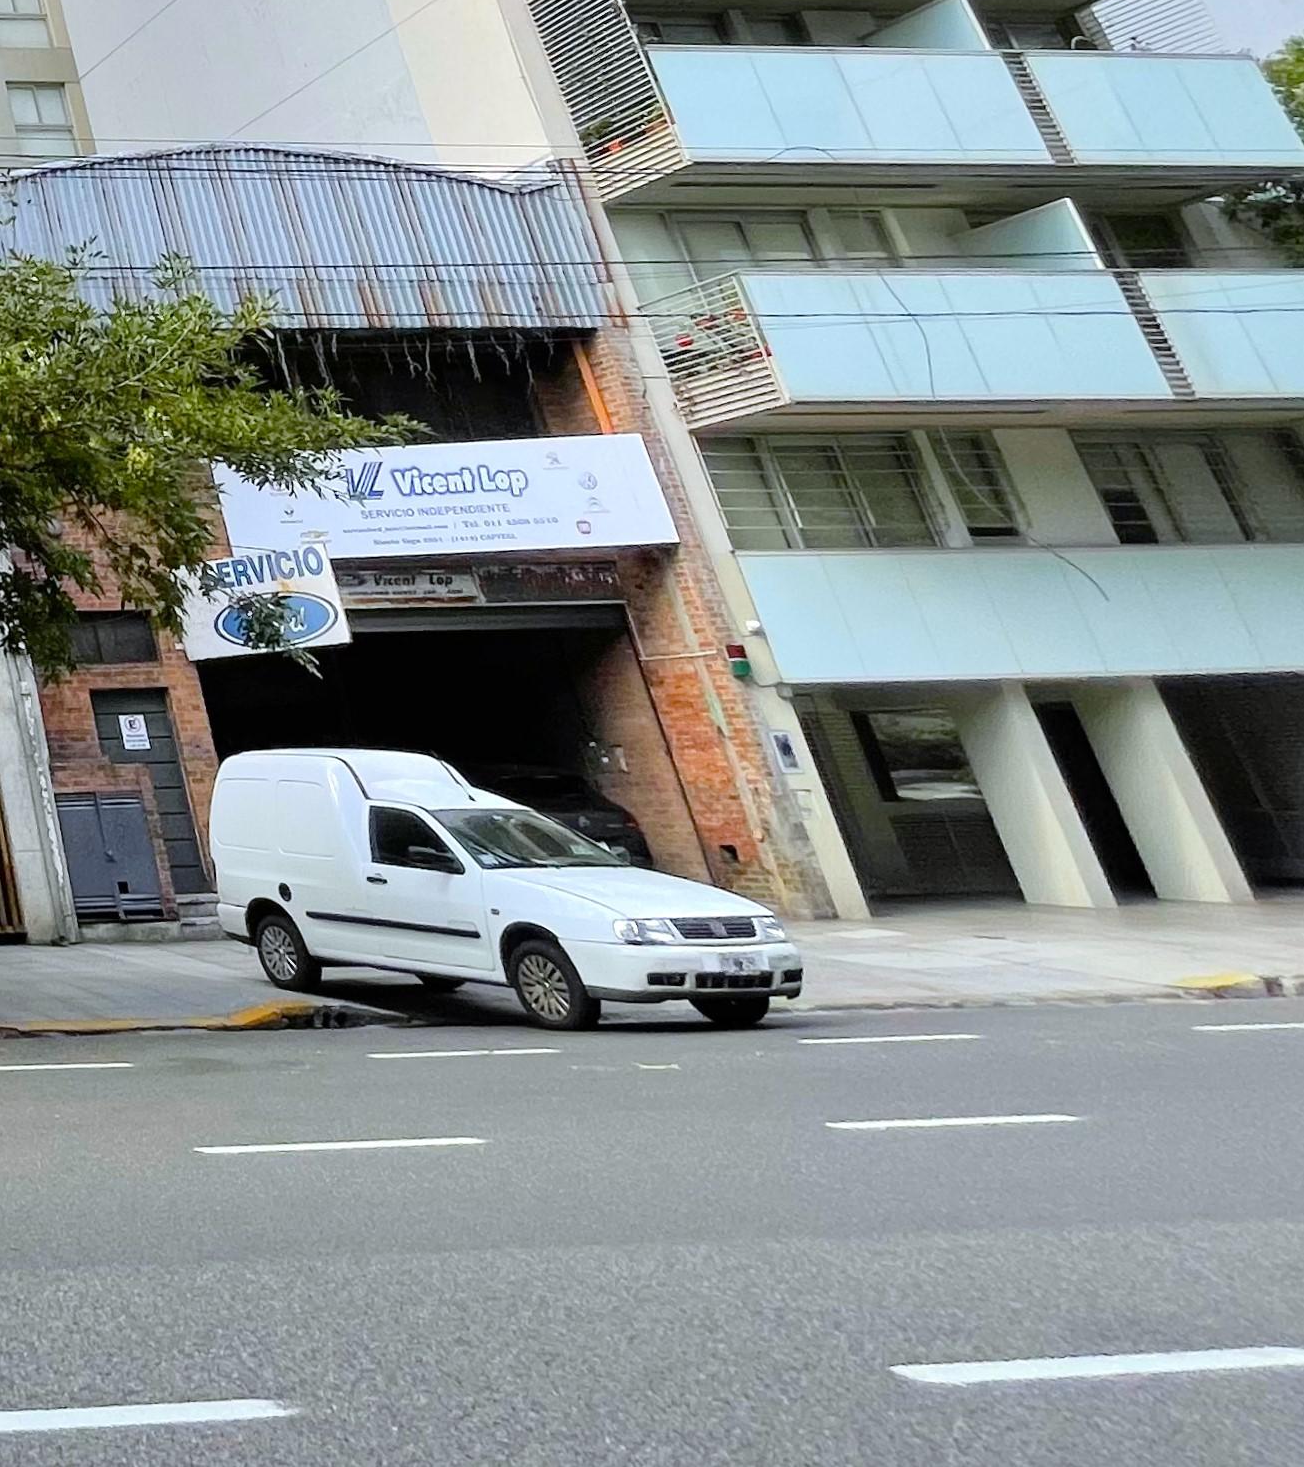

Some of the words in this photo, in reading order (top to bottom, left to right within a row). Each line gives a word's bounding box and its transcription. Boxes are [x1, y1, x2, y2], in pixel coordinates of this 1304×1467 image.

[391, 465, 475, 496] Vicent
[478, 464, 528, 497] Lop
[361, 508, 415, 520] SERVICIO
[417, 503, 511, 518] INDEPENDIENTE
[204, 545, 324, 590] ERVICIO
[373, 572, 416, 586] Vicent
[429, 572, 453, 587] Lop
